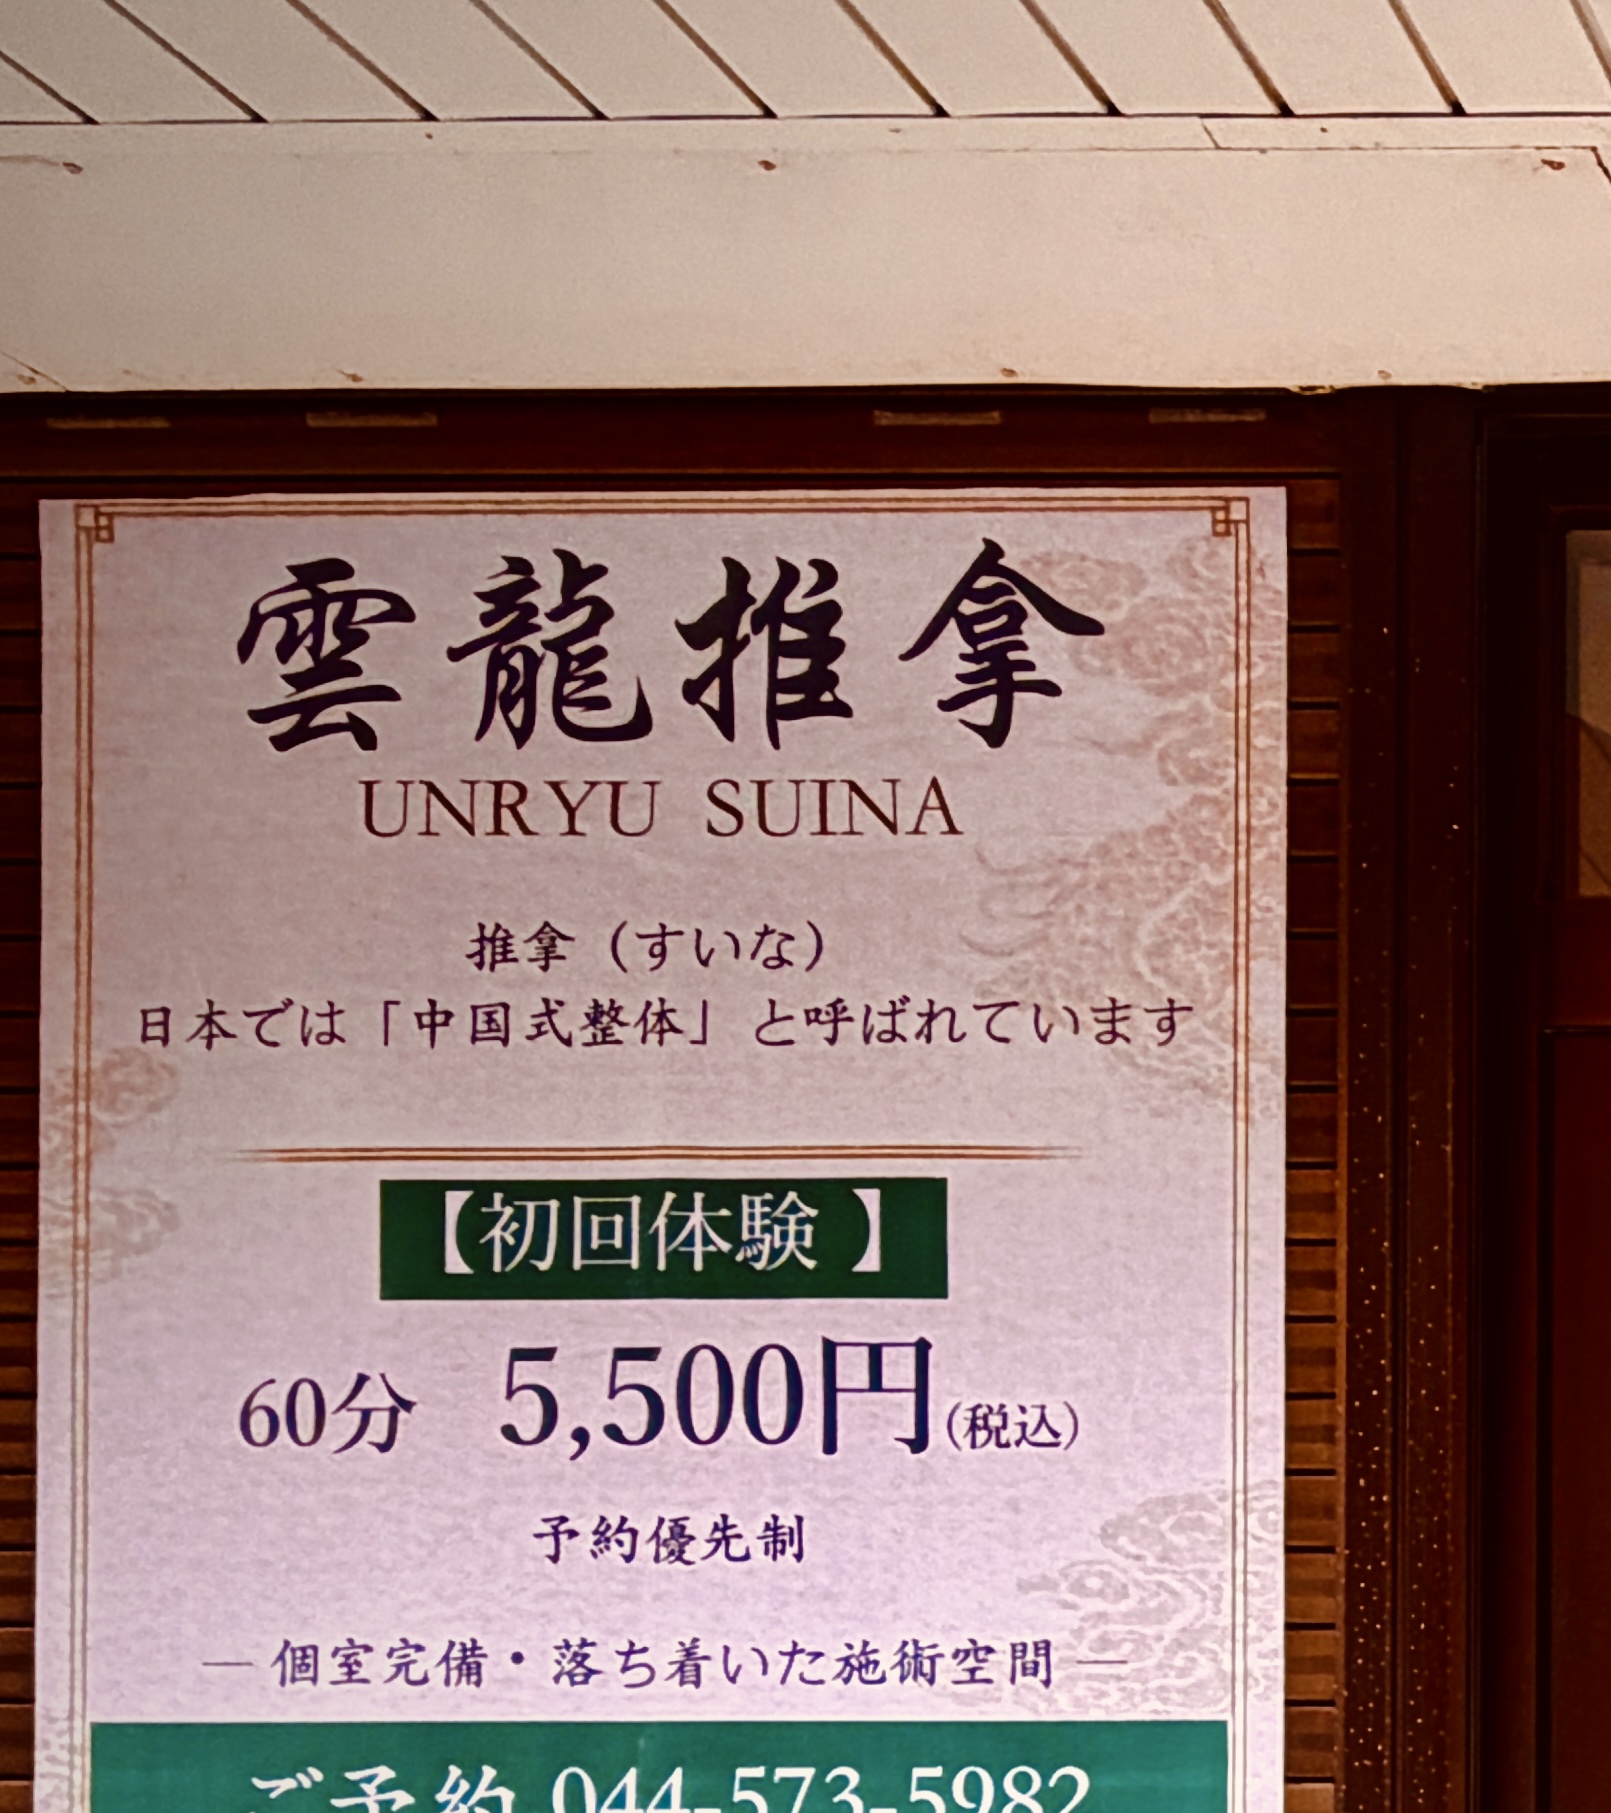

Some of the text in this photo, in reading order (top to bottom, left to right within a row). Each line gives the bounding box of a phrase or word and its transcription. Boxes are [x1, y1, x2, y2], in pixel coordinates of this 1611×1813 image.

[236, 538, 1106, 754] 雲龍推拿
[359, 777, 965, 839] UNRYU SUINA
[139, 998, 1195, 1052] 日本では「中国式整体」と呼ばれています
[445, 1188, 882, 1276] 【初回体験】
[239, 1372, 418, 1455] 60分
[500, 1336, 934, 1462] 5,500円
[534, 1514, 805, 1567] 予約優先制
[273, 1637, 1056, 1690] 個室完備・落ち着いた施術空間
